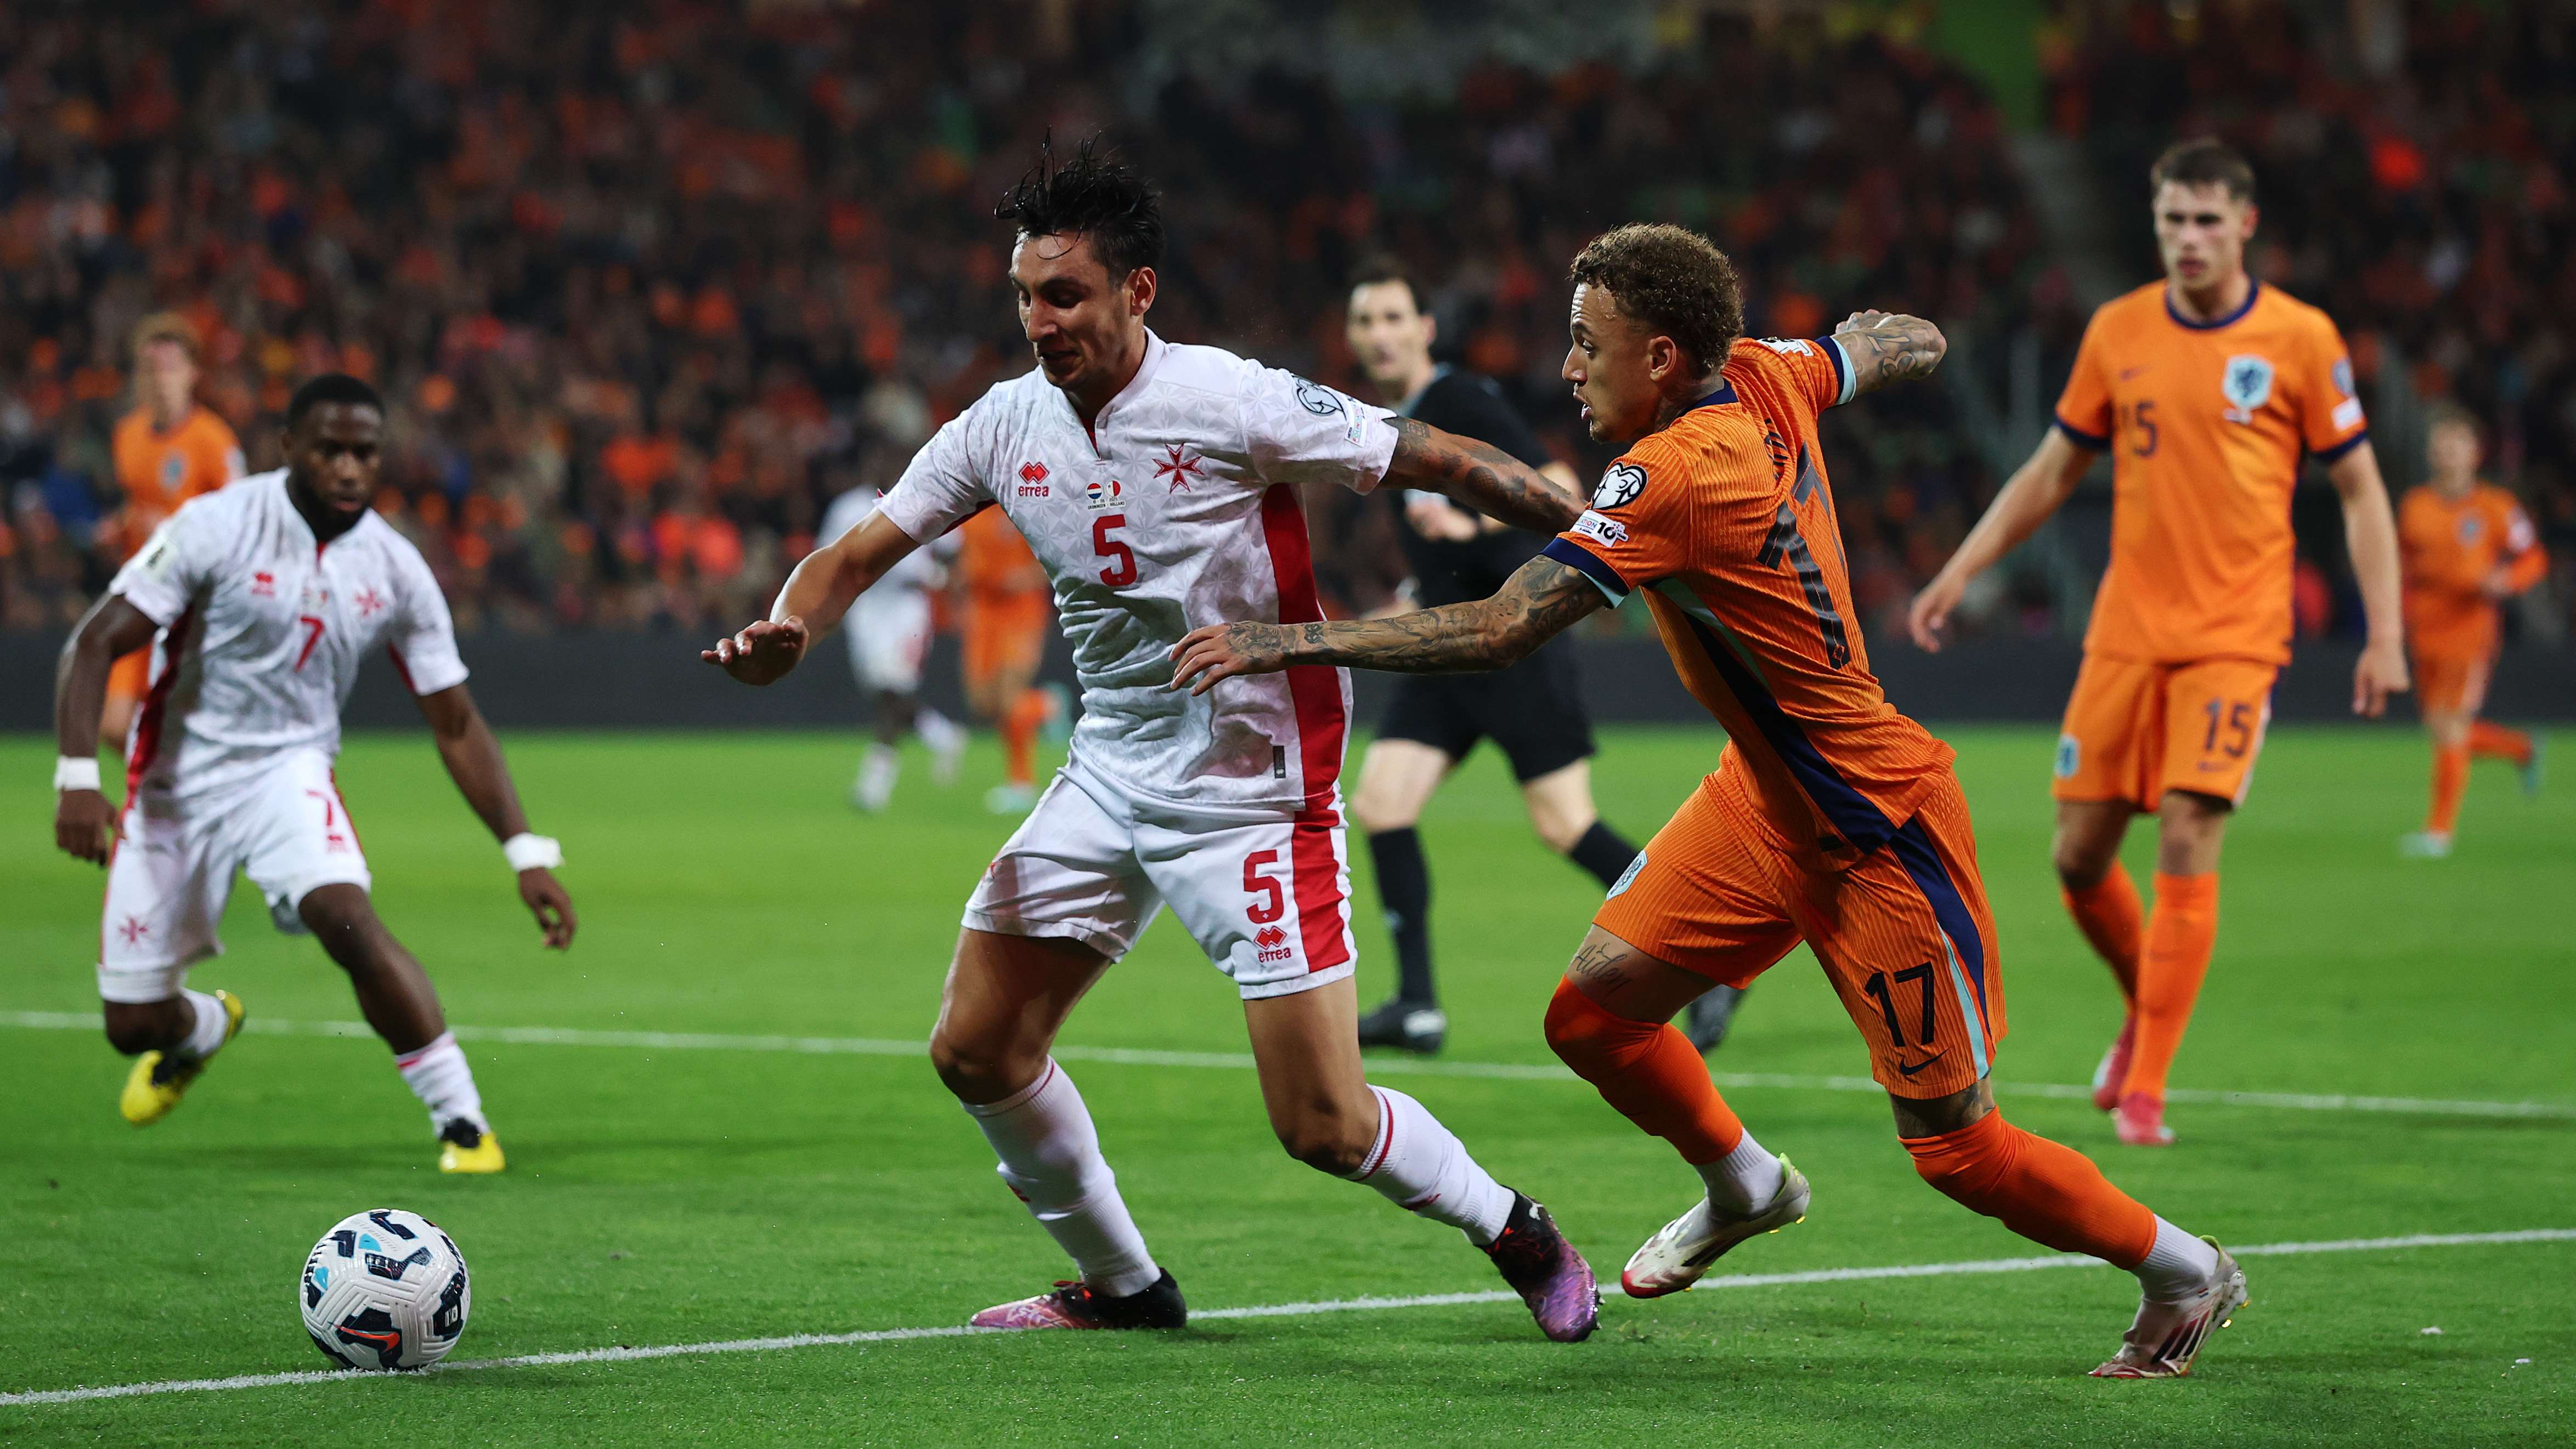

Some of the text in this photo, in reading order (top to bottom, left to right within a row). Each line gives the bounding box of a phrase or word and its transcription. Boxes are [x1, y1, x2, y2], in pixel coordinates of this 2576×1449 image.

[1018, 486, 1050, 497] errea
[1092, 514, 1137, 586] 5
[295, 616, 325, 673] 7
[2204, 698, 2251, 757] 15
[306, 789, 332, 826] 7
[1243, 849, 1284, 924] 5
[1258, 946, 1291, 963] errea
[1866, 961, 1935, 1047] 17
